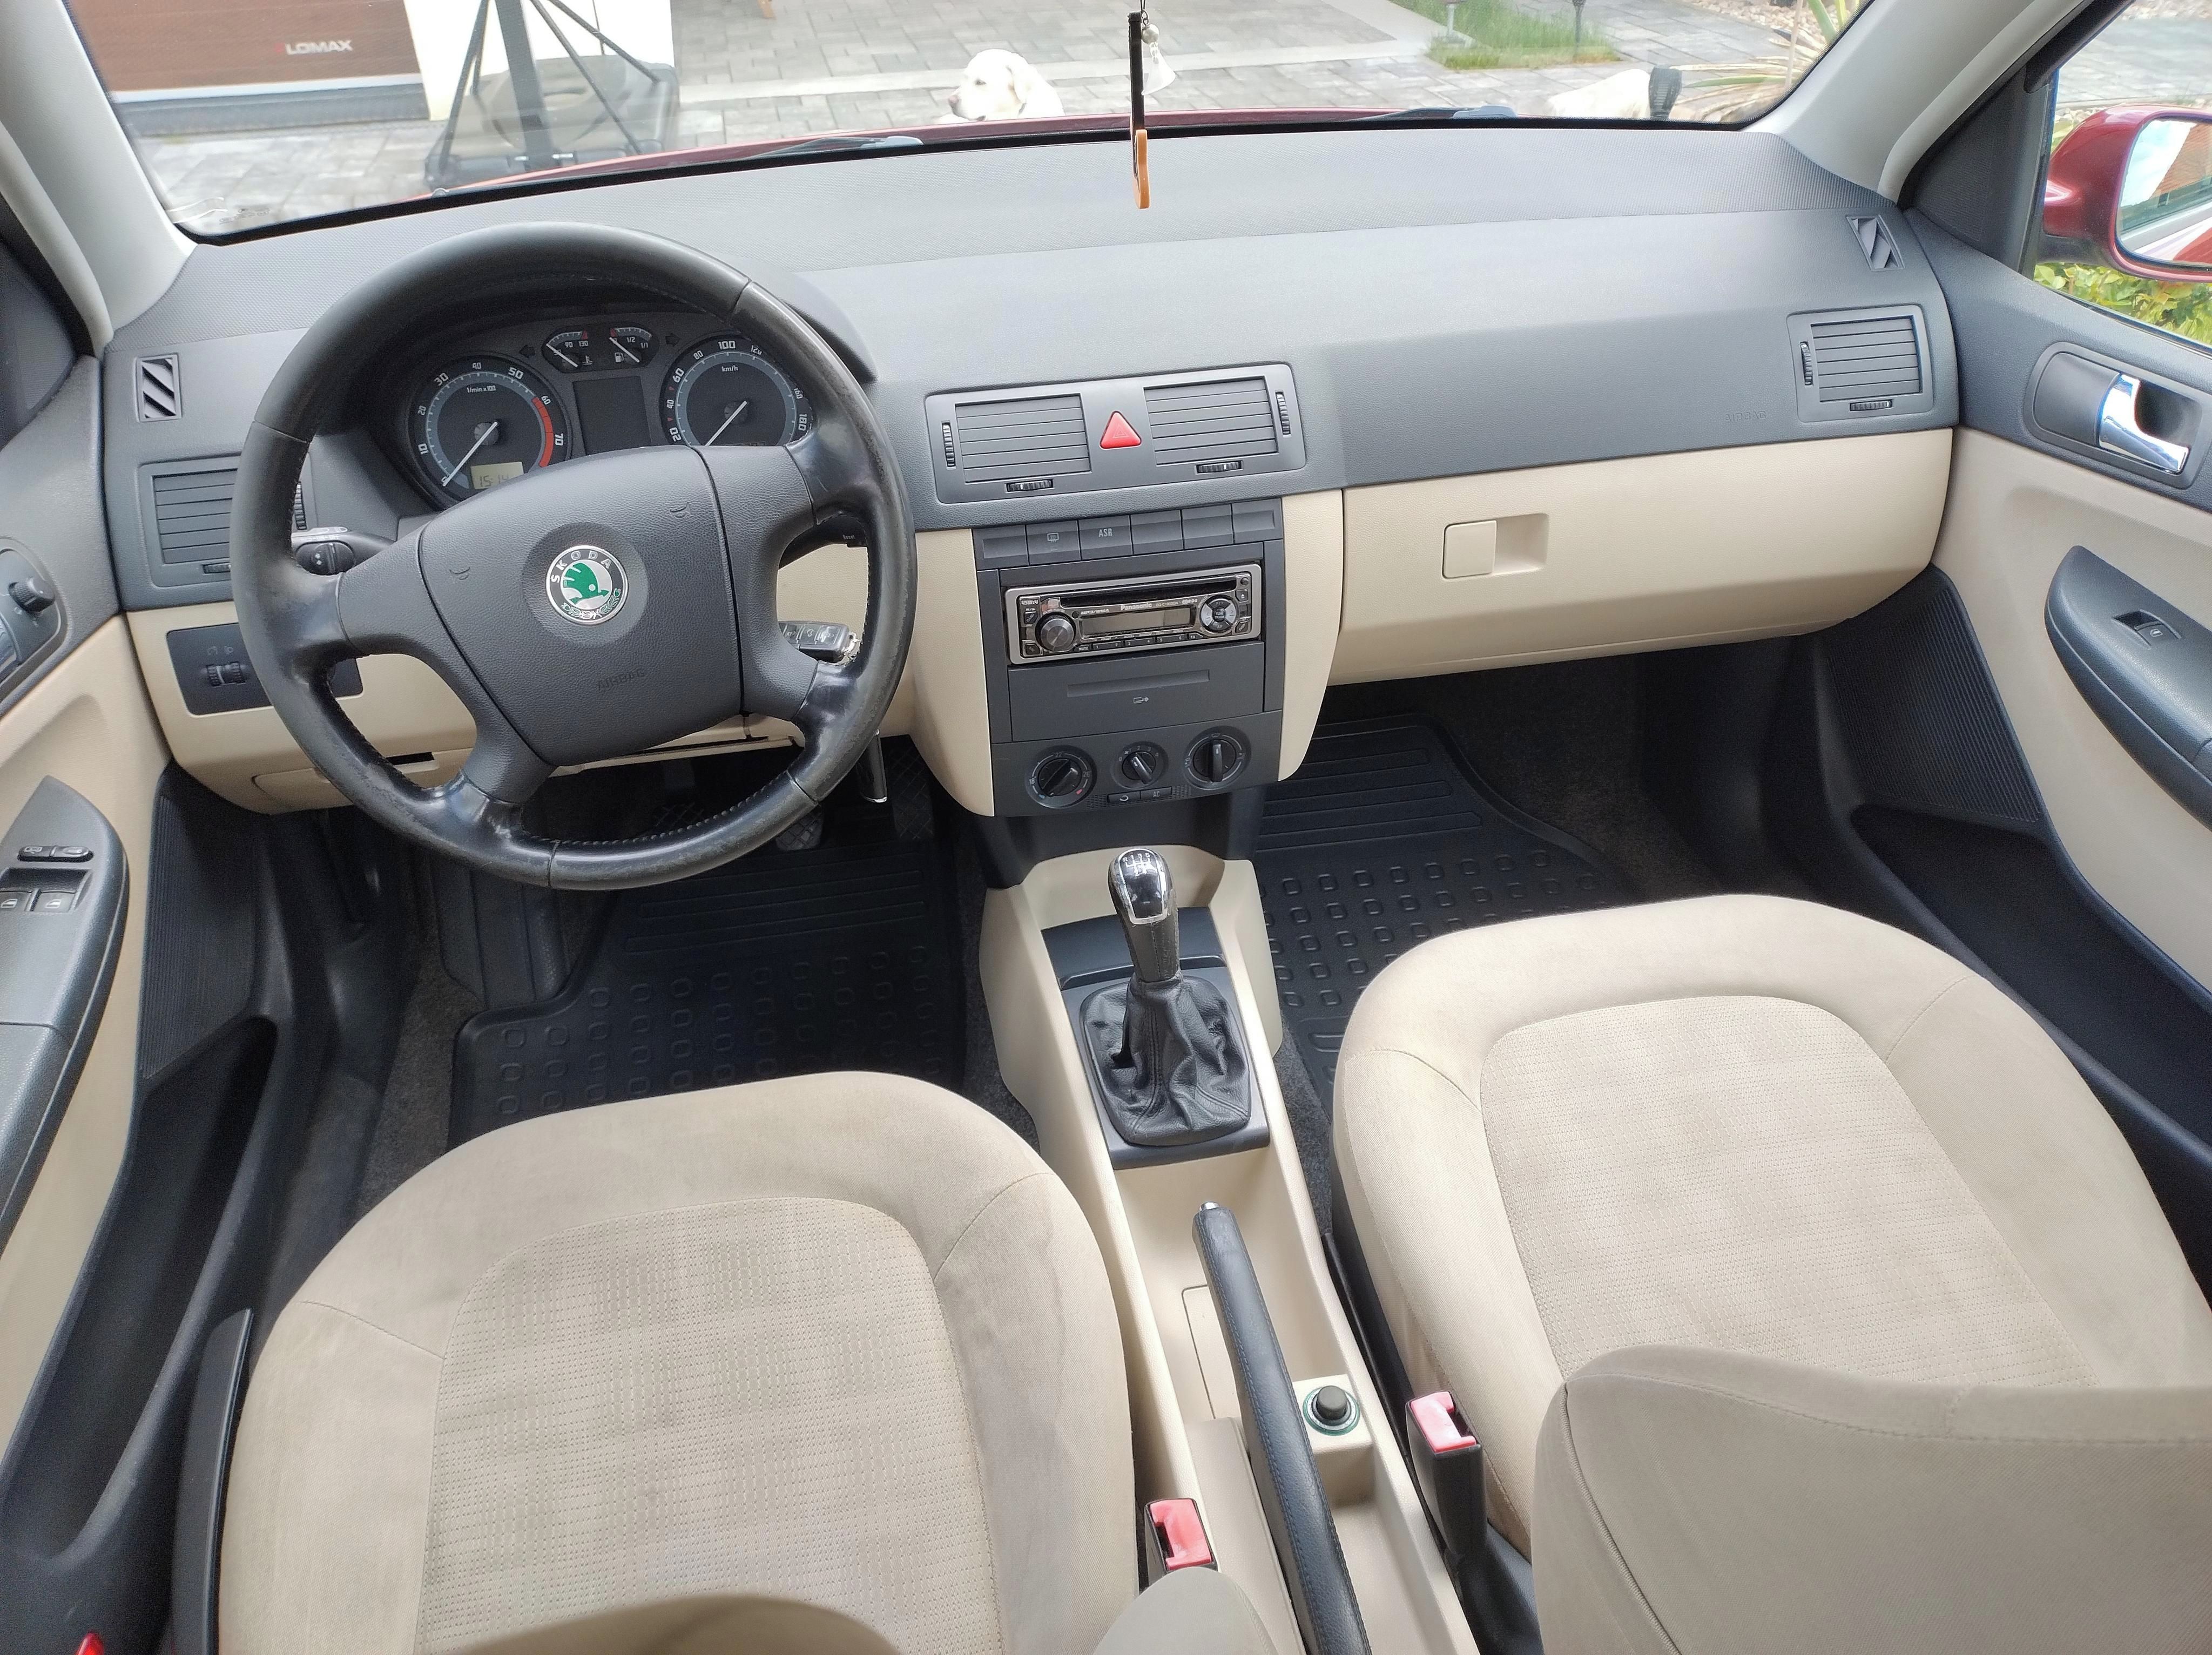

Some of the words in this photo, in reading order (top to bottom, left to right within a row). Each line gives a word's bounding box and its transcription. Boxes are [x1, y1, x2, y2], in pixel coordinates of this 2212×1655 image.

[285, 39, 353, 55] LOMAX
[718, 340, 736, 350] 100
[693, 350, 704, 361] 80
[434, 372, 449, 386] 30
[508, 367, 524, 380] 50
[672, 368, 685, 383] 60
[541, 395, 551, 406] 60
[666, 399, 675, 409] 40
[418, 406, 427, 416] 20
[1725, 410, 1767, 423] AIRBAG
[798, 413, 807, 431] 180
[555, 433, 564, 446] 70
[669, 427, 682, 442] 20
[418, 443, 429, 455] 10
[1098, 528, 1112, 537] ASR
[1120, 602, 1152, 611] Panasonic
